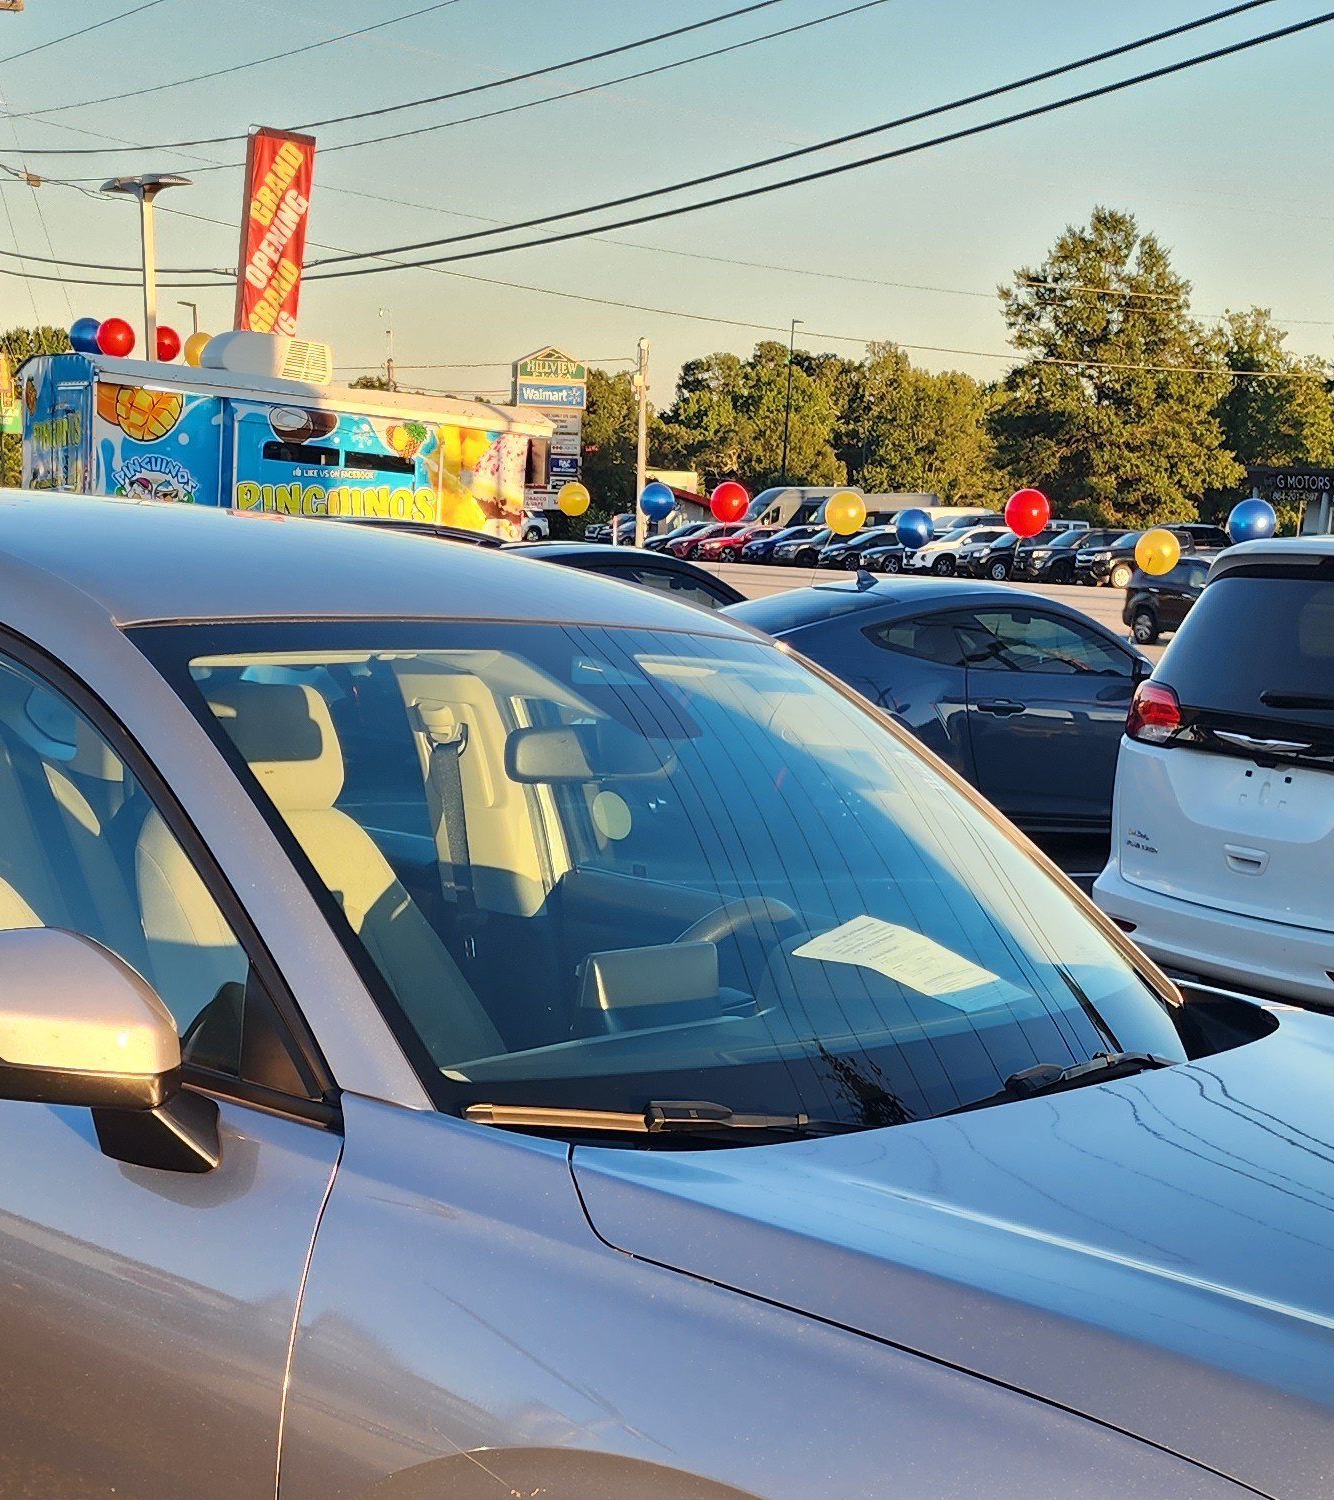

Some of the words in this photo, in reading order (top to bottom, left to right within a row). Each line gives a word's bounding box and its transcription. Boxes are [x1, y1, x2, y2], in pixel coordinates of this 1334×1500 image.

[250, 141, 304, 227] GRAND
[245, 189, 309, 289] OPENING
[249, 257, 300, 334] GRAND
[527, 360, 578, 374] HILLVIEW
[522, 387, 568, 402] Walmart
[113, 454, 199, 493] PINGUINOS
[303, 469, 318, 478] LIKE
[319, 469, 329, 478] US
[329, 469, 340, 479] ON
[1276, 475, 1285, 488] G
[1287, 475, 1331, 490] MOTORS
[236, 481, 437, 523] PINGUINOS
